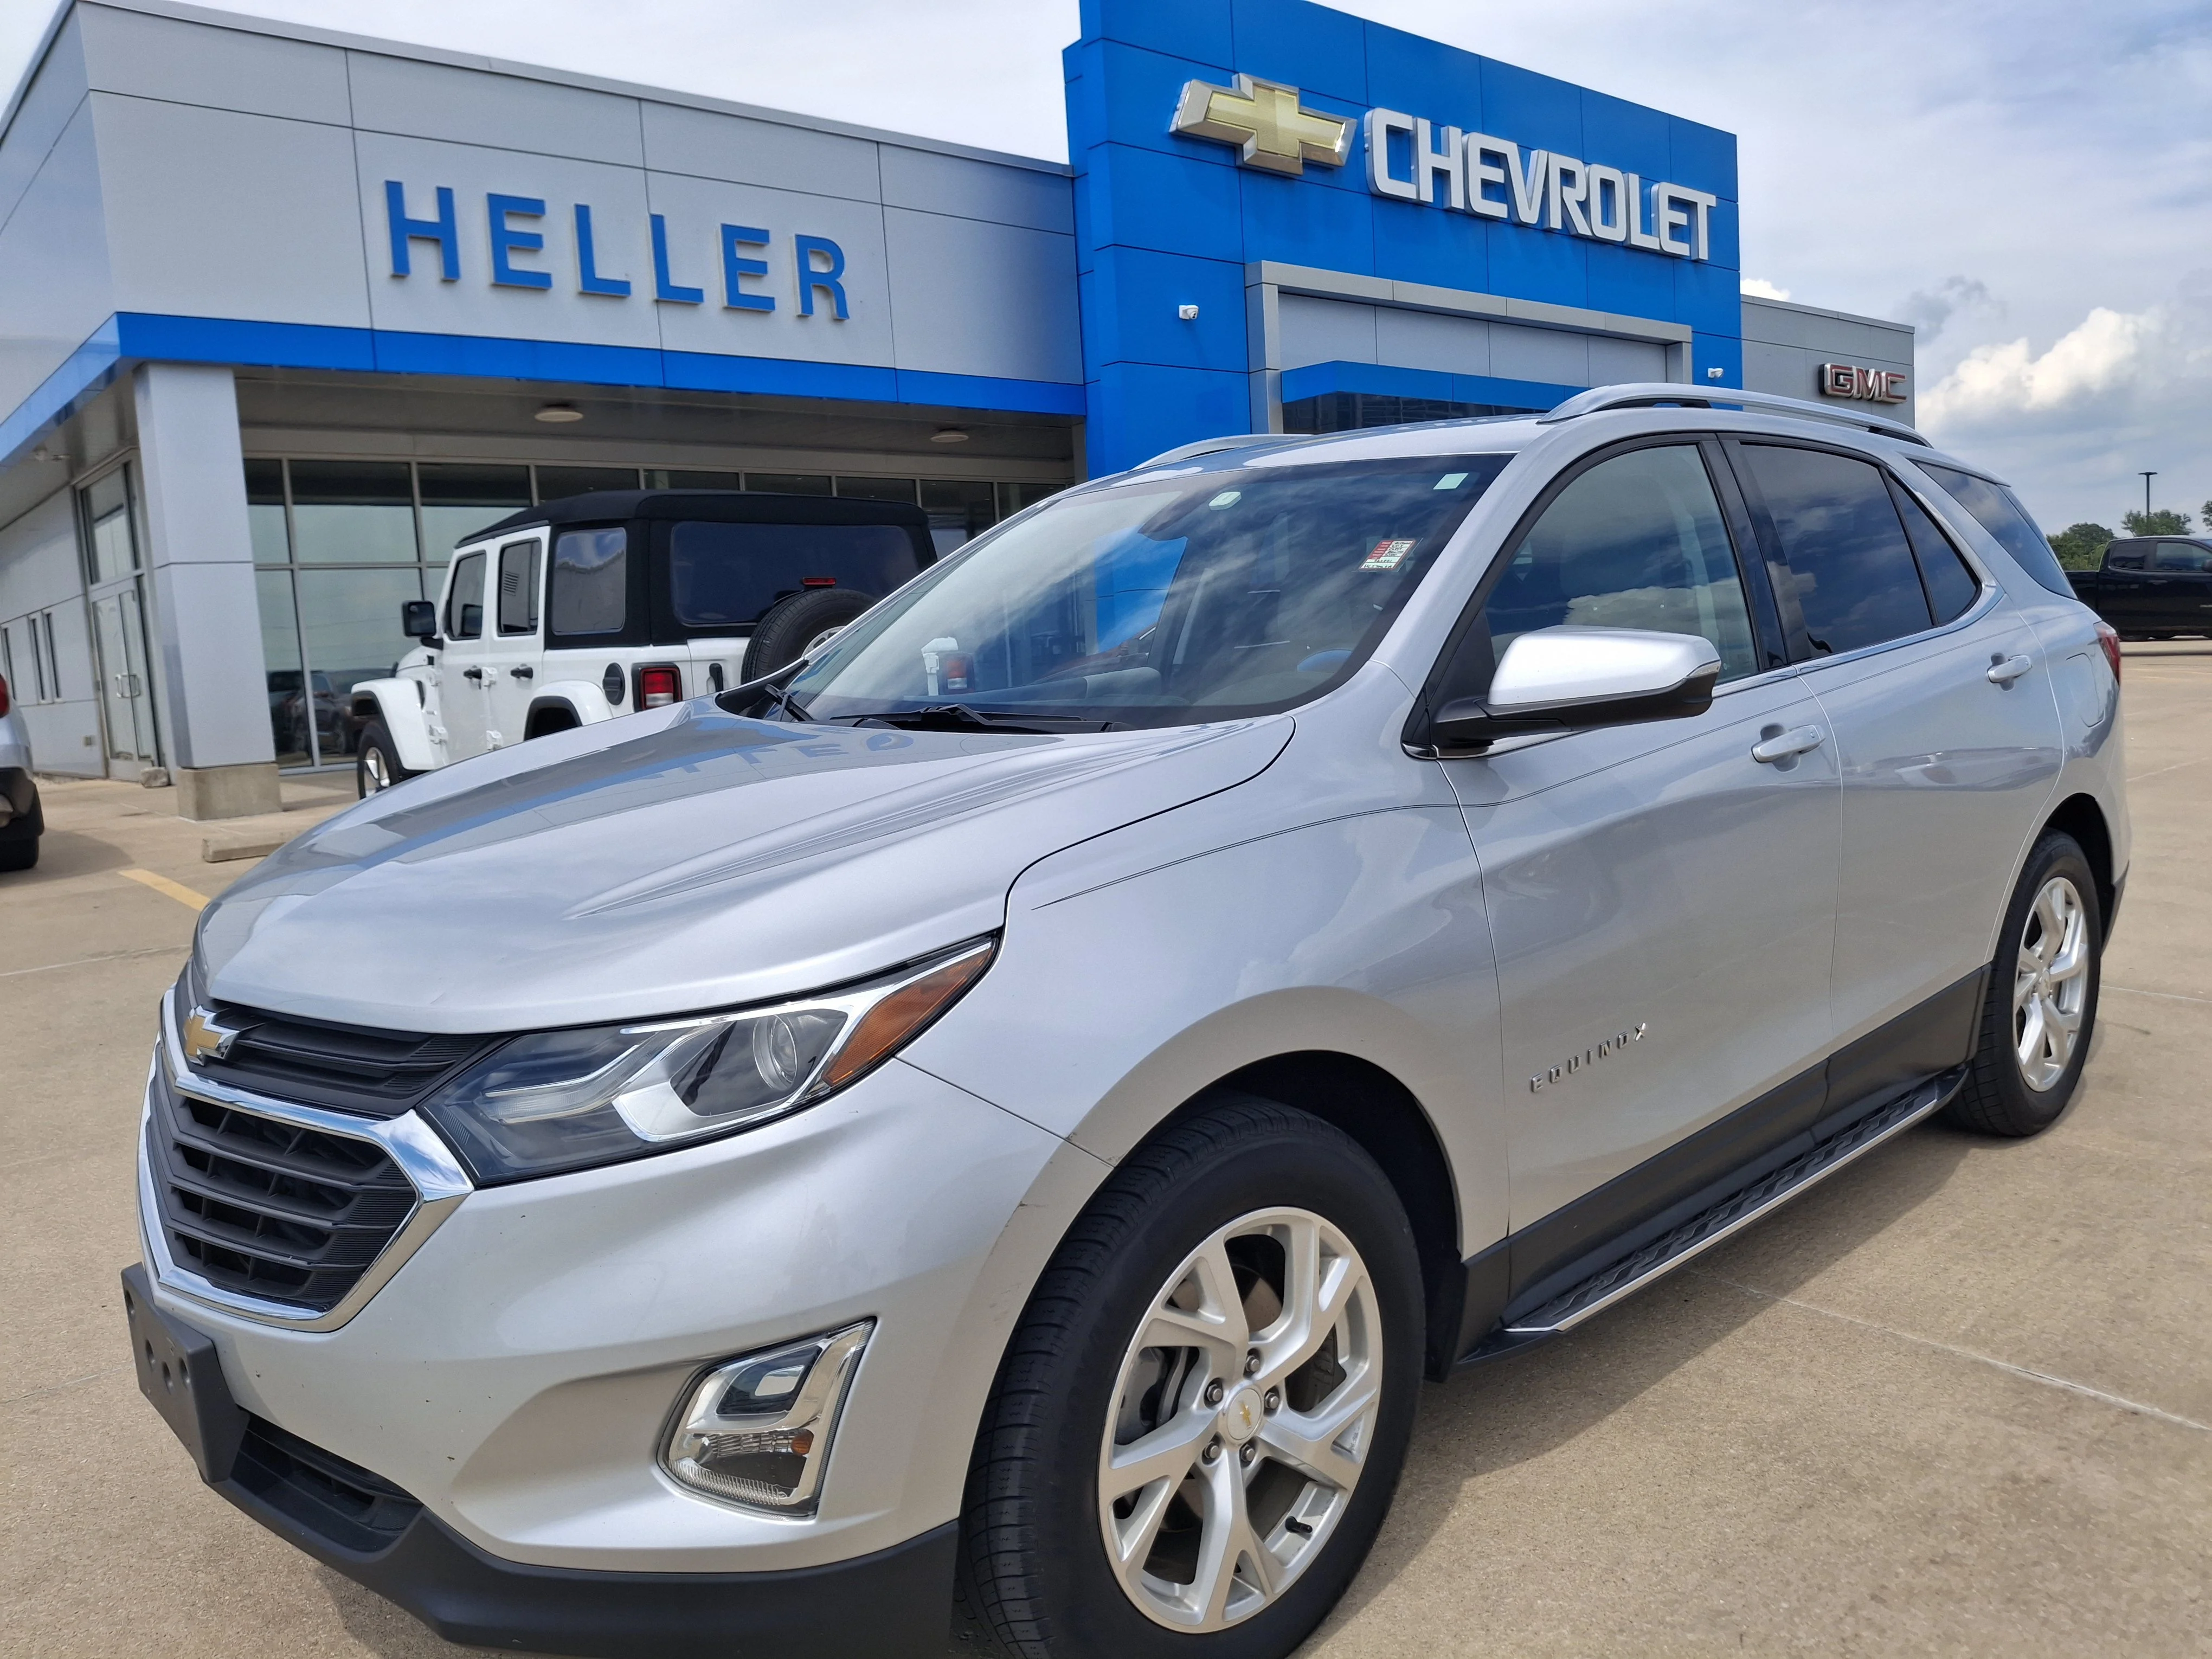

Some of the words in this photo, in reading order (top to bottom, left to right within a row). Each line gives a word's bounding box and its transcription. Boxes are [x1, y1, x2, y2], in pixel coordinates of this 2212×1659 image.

[1364, 107, 1716, 261] CHEVROLET
[384, 180, 850, 321] HELLER
[1819, 363, 1907, 404] GMC
[1531, 1022, 1647, 1093] EQUINOX
